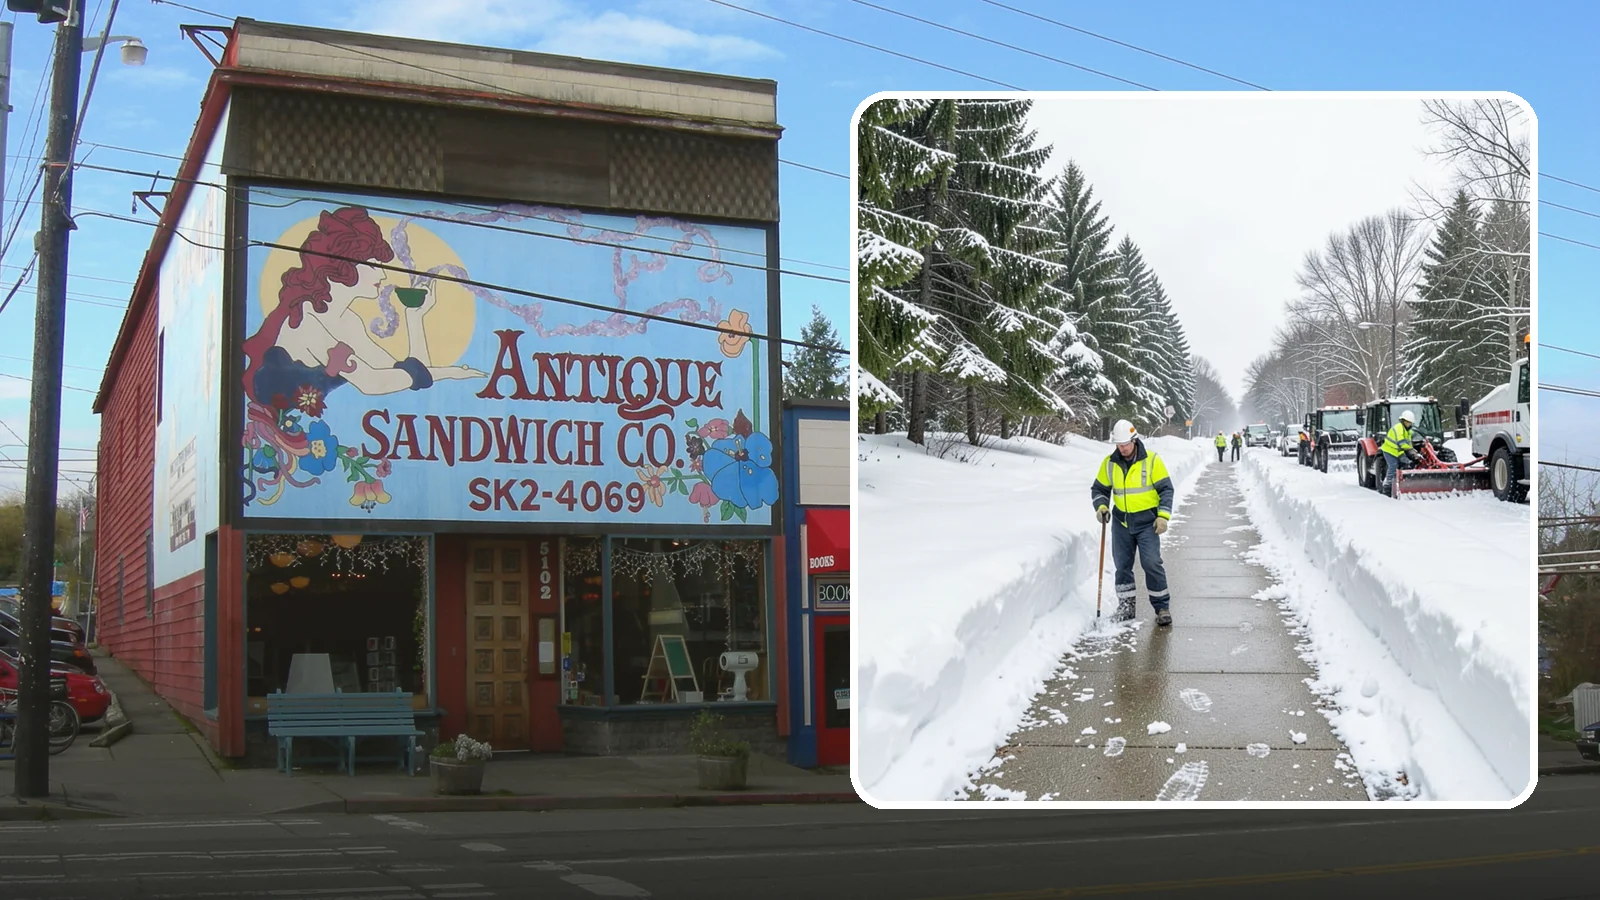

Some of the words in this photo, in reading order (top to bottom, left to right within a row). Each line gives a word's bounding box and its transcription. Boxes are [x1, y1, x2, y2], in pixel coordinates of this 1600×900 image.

[475, 329, 724, 421] ANTIQUE
[361, 409, 604, 467] SANDWICH
[617, 421, 685, 469] CO.
[468, 477, 646, 513] SK2-4069
[539, 541, 552, 600] 5102
[809, 555, 835, 569] BOOKS
